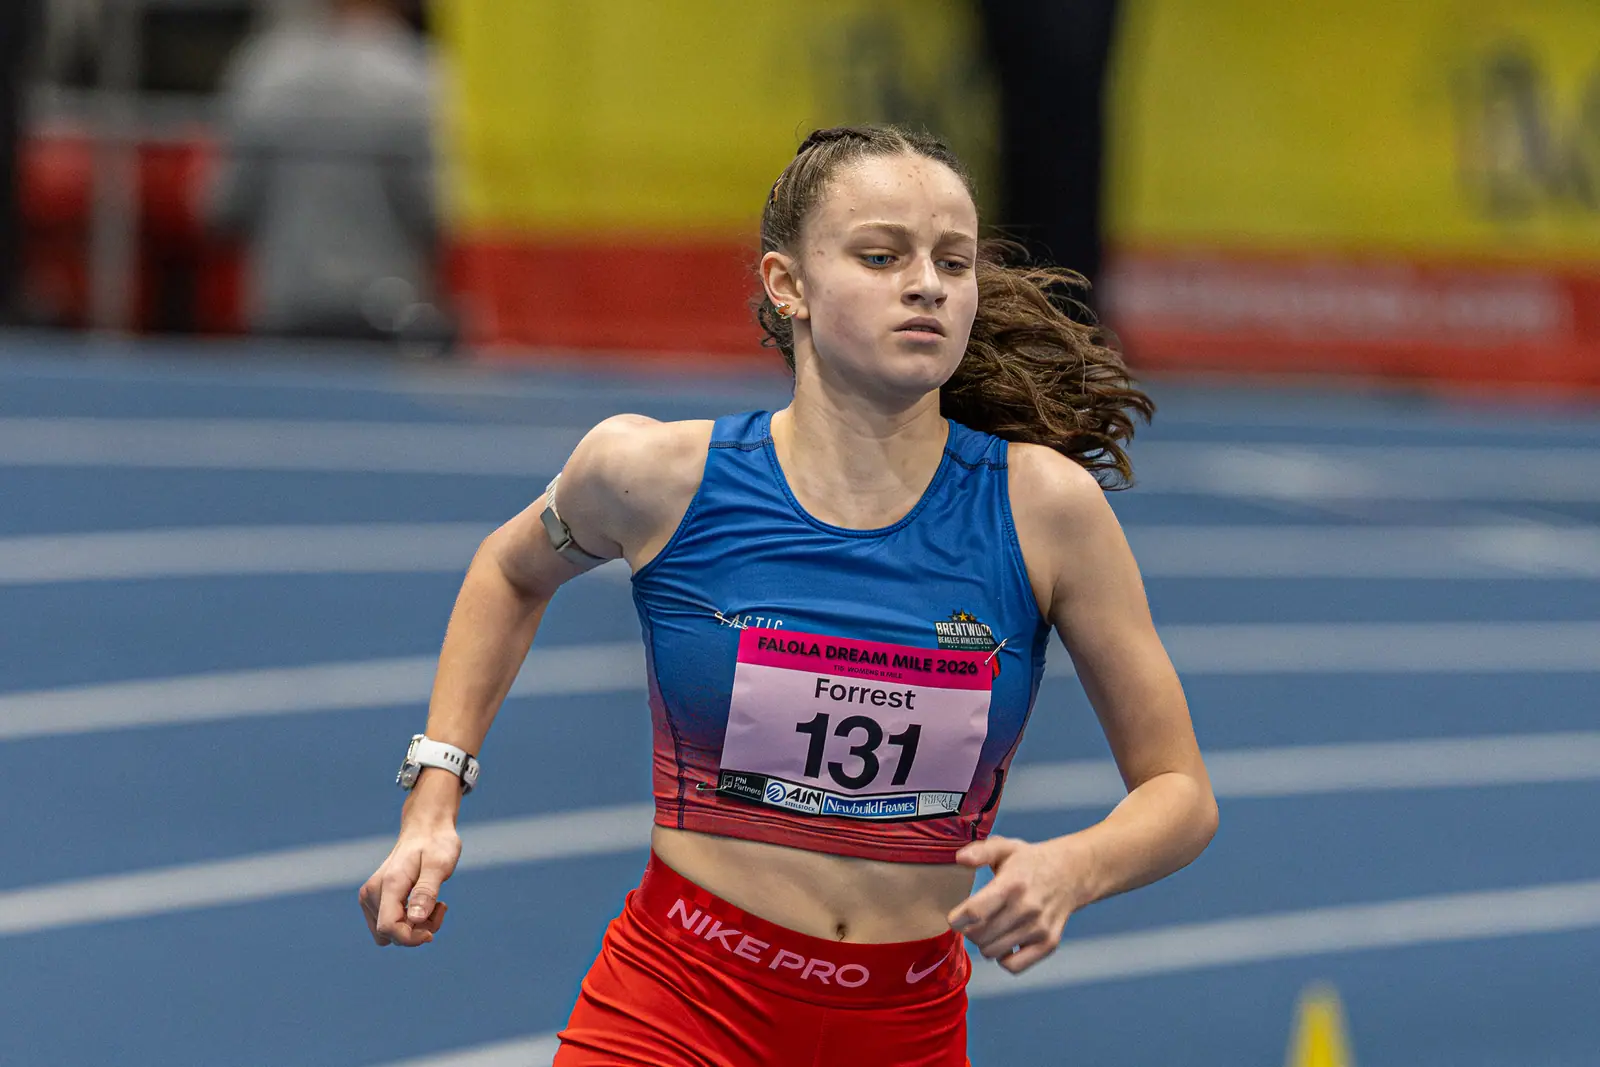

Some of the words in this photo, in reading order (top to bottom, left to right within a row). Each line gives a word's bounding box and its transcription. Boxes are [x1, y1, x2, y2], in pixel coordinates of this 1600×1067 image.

[757, 636, 821, 658] FALOLA
[825, 645, 889, 667] DREAM
[892, 653, 933, 673] MILE
[936, 659, 979, 676] 2026
[848, 666, 879, 677] WOMENS
[886, 671, 903, 679] MILE
[815, 677, 916, 711] Forrest
[796, 712, 922, 790] 131
[733, 782, 762, 796] Partners
[786, 787, 822, 807] AJN
[784, 800, 816, 812] STEELSTOCK
[666, 898, 771, 964] NIKE
[768, 948, 870, 988] PRO
